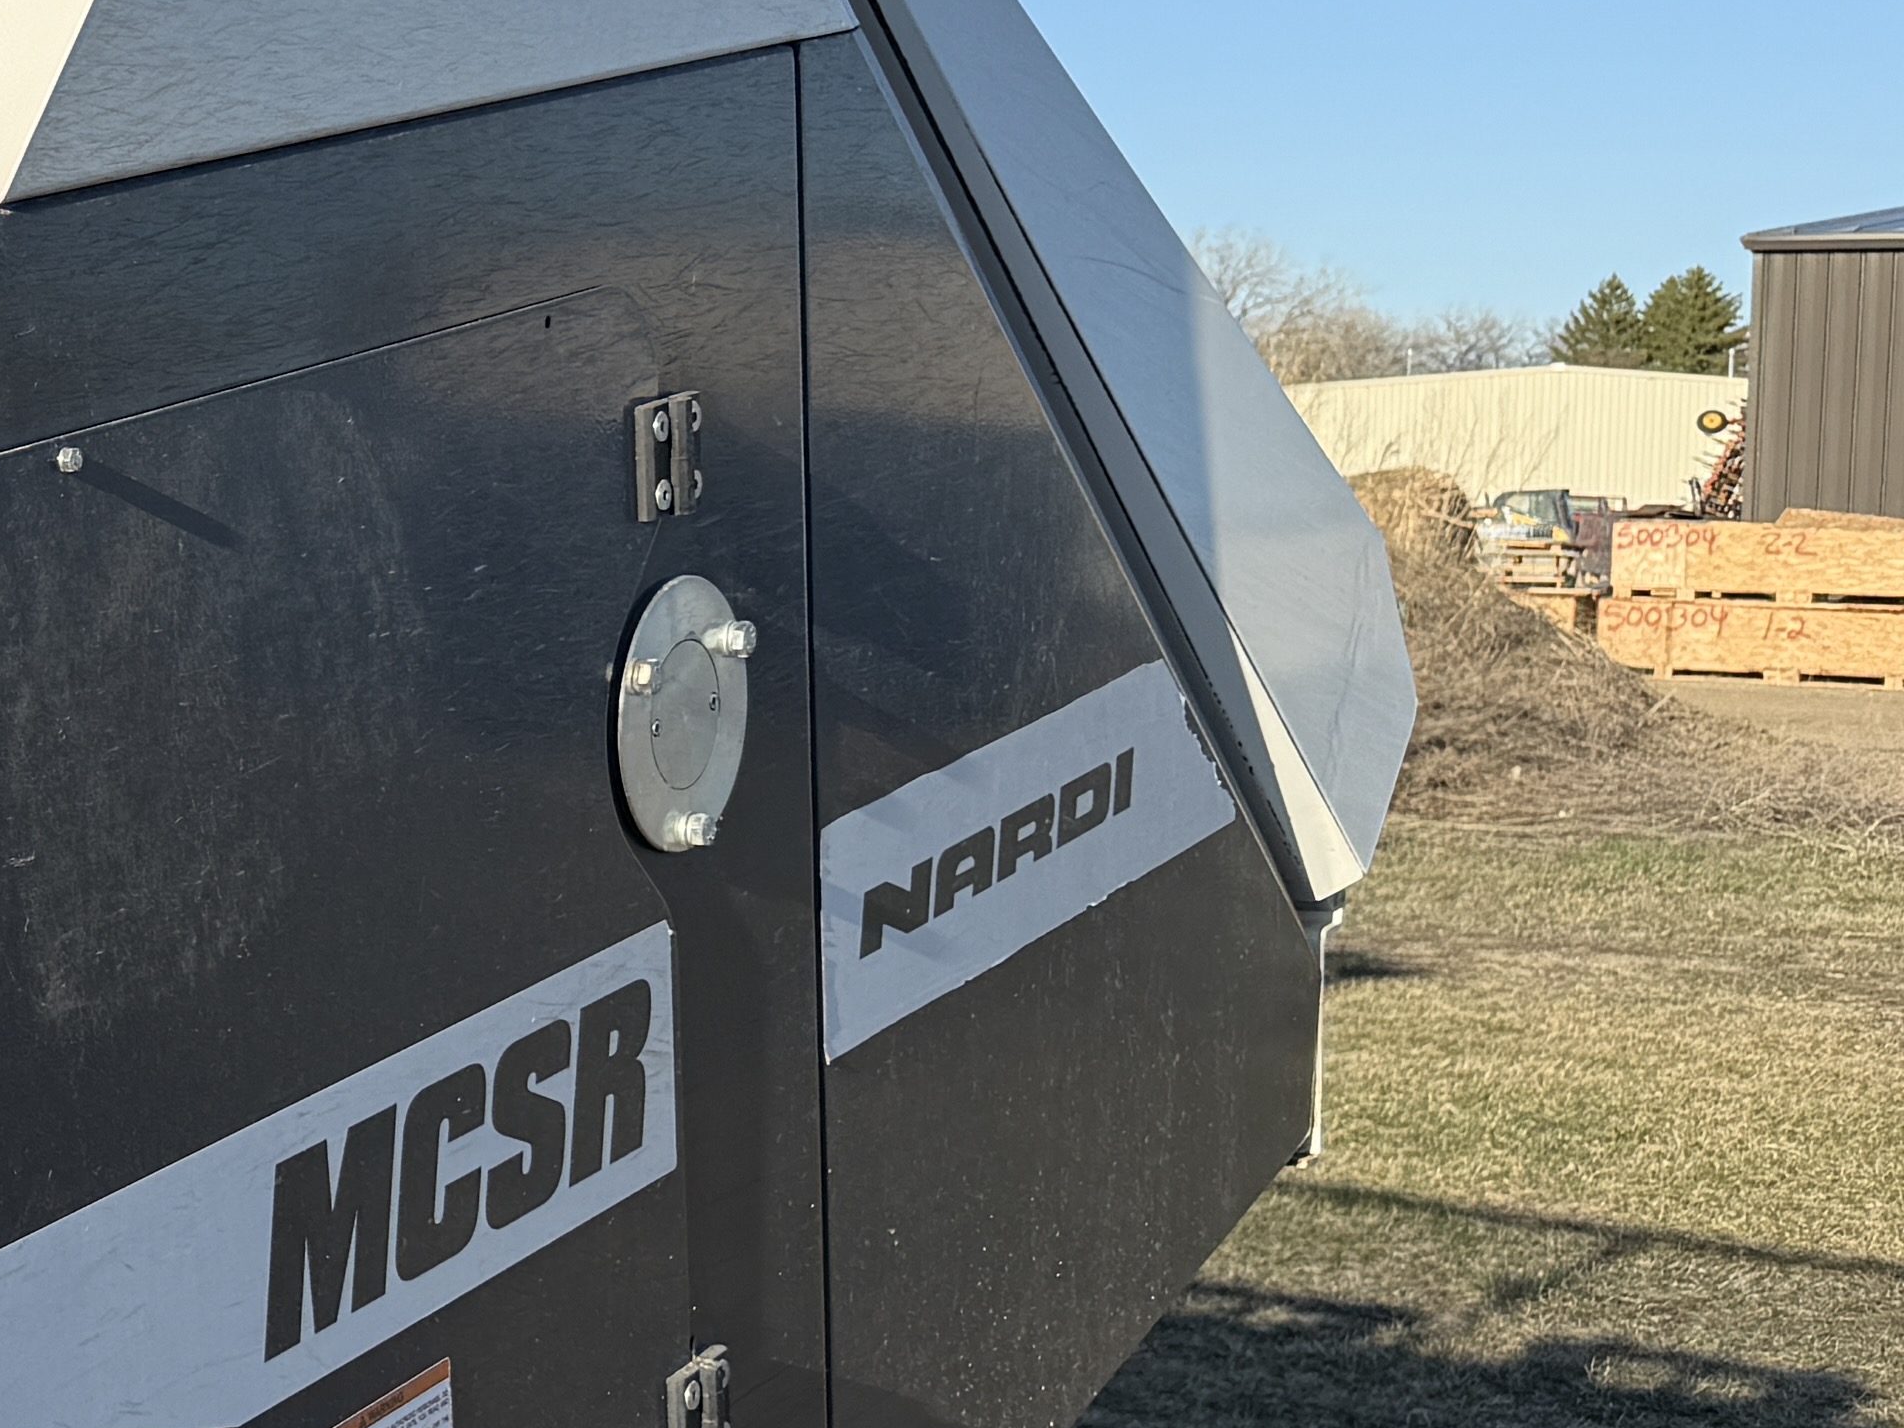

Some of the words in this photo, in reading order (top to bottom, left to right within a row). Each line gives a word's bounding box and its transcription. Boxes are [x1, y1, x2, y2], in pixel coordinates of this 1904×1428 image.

[1617, 523, 1719, 555] 500304
[1604, 601, 1728, 640] 500304
[858, 747, 1136, 960] NARDI
[265, 978, 653, 1364] MCSR
